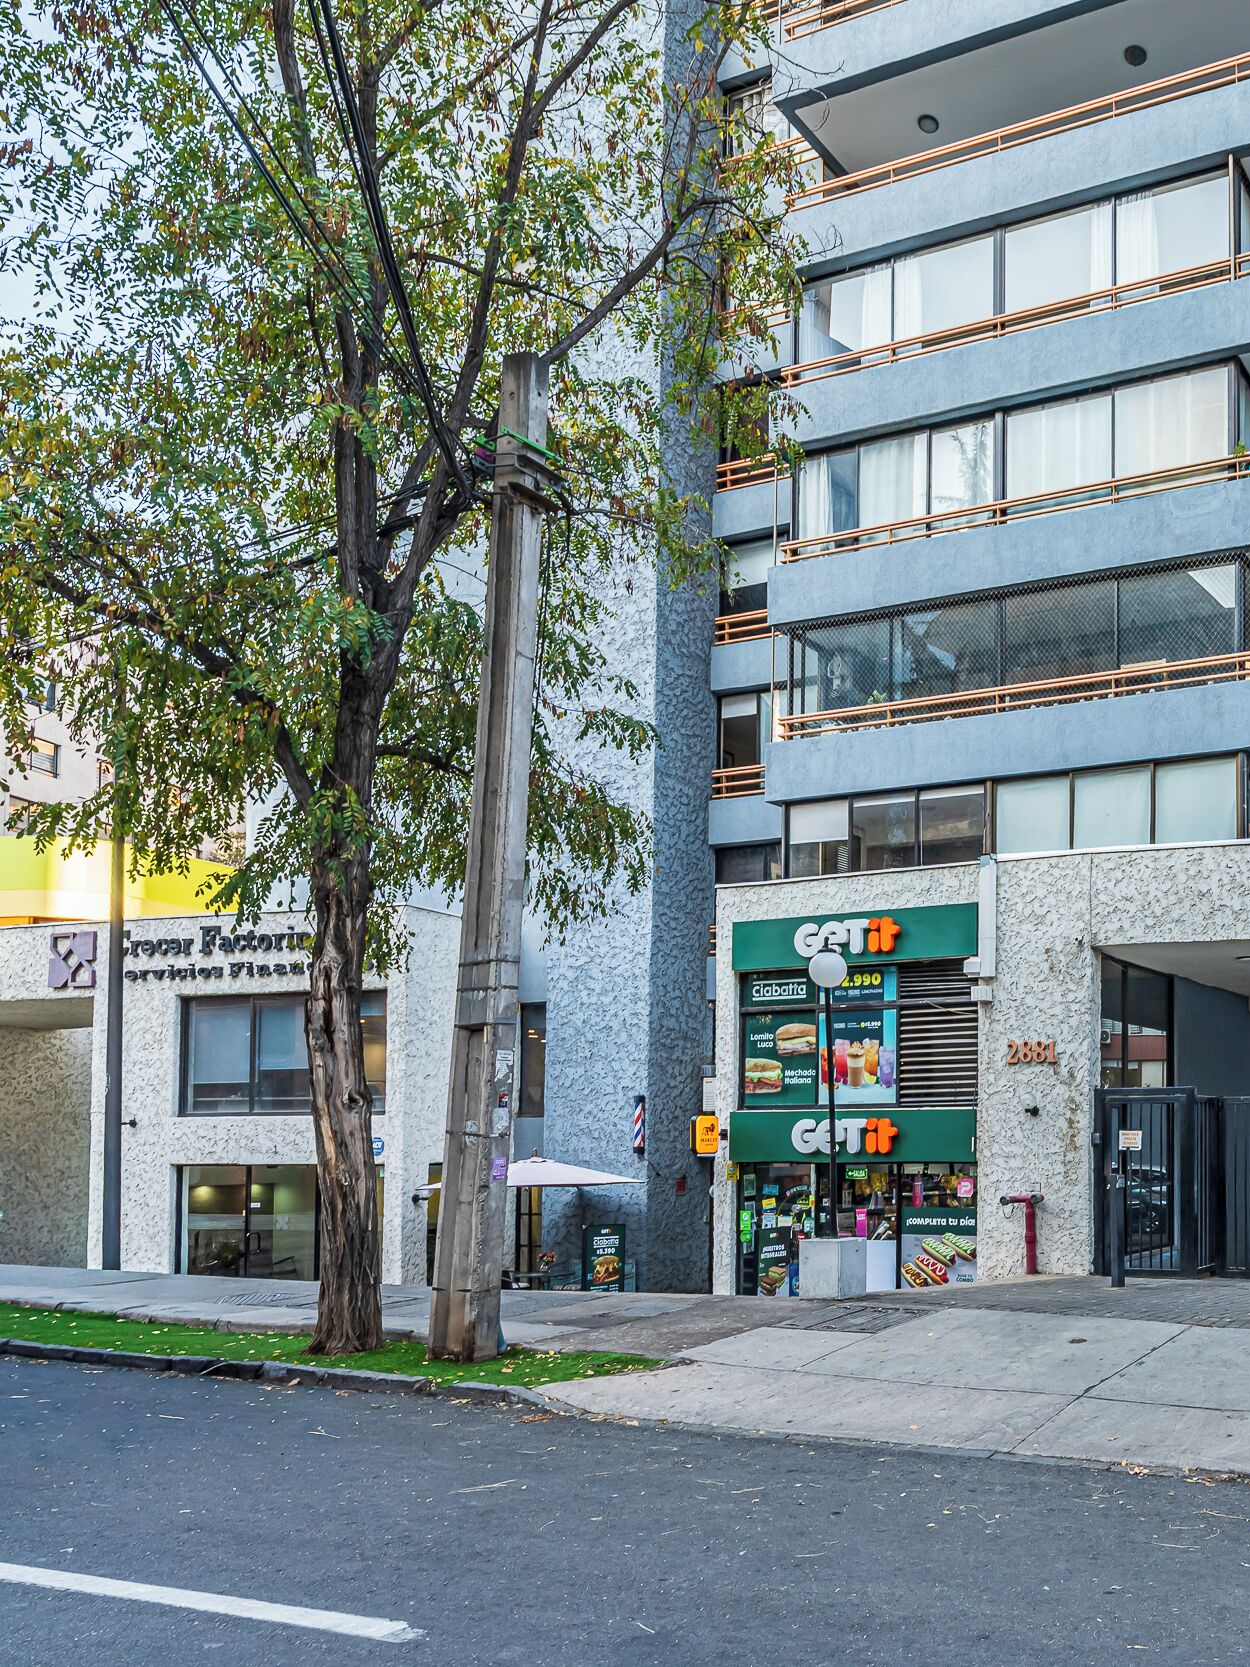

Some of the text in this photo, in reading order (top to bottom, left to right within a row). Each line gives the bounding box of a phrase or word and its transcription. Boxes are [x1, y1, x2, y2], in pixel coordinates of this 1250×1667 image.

[124, 963, 223, 981] ervicios
[751, 1032, 774, 1041] Lomito
[1007, 1039, 1056, 1064] 2881
